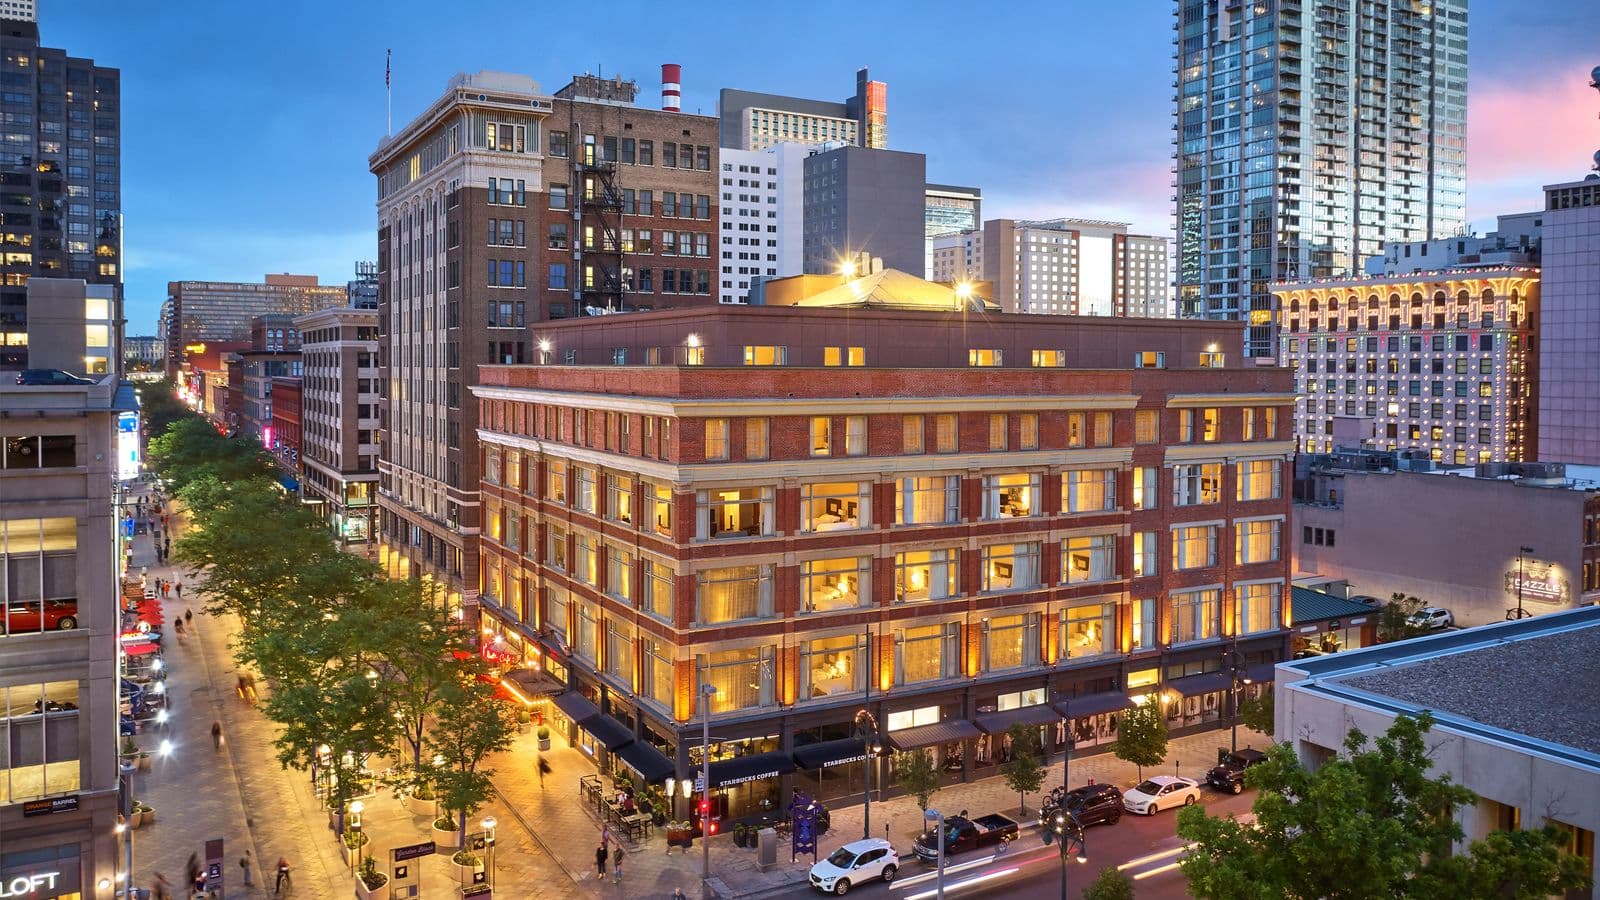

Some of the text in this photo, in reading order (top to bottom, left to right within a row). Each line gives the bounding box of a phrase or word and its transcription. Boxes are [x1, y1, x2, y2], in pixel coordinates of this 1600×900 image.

[1514, 578, 1561, 593] DAZZLE
[823, 756, 857, 768] STARBUCKS
[720, 770, 779, 787] STARBUCKS COFFEE
[52, 798, 78, 806] BARREL
[0, 871, 60, 897] LOFT
